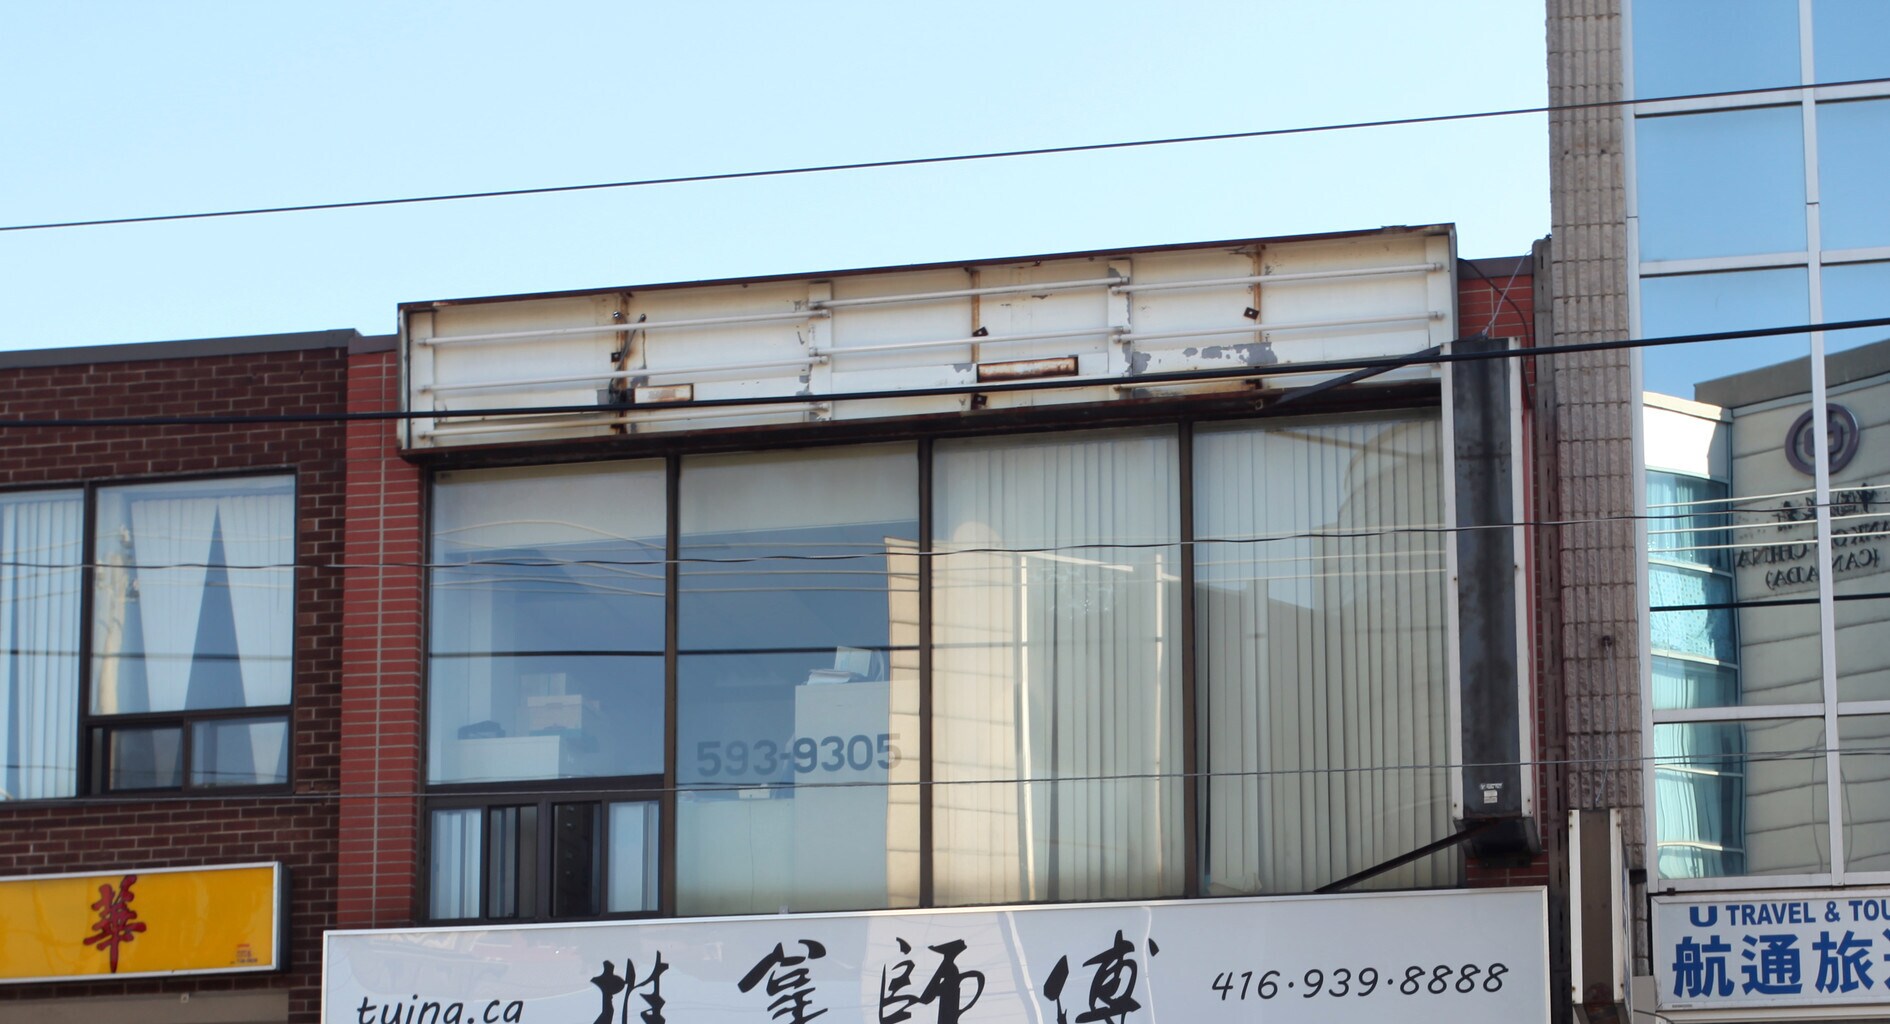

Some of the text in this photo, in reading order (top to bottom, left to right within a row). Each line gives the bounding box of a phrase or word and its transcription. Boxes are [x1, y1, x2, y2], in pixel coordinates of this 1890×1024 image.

[696, 733, 902, 777] 593-9305
[83, 874, 147, 973] 華
[1689, 906, 1718, 927] U
[1726, 902, 1816, 926] TRAVEL
[1824, 901, 1841, 922] &
